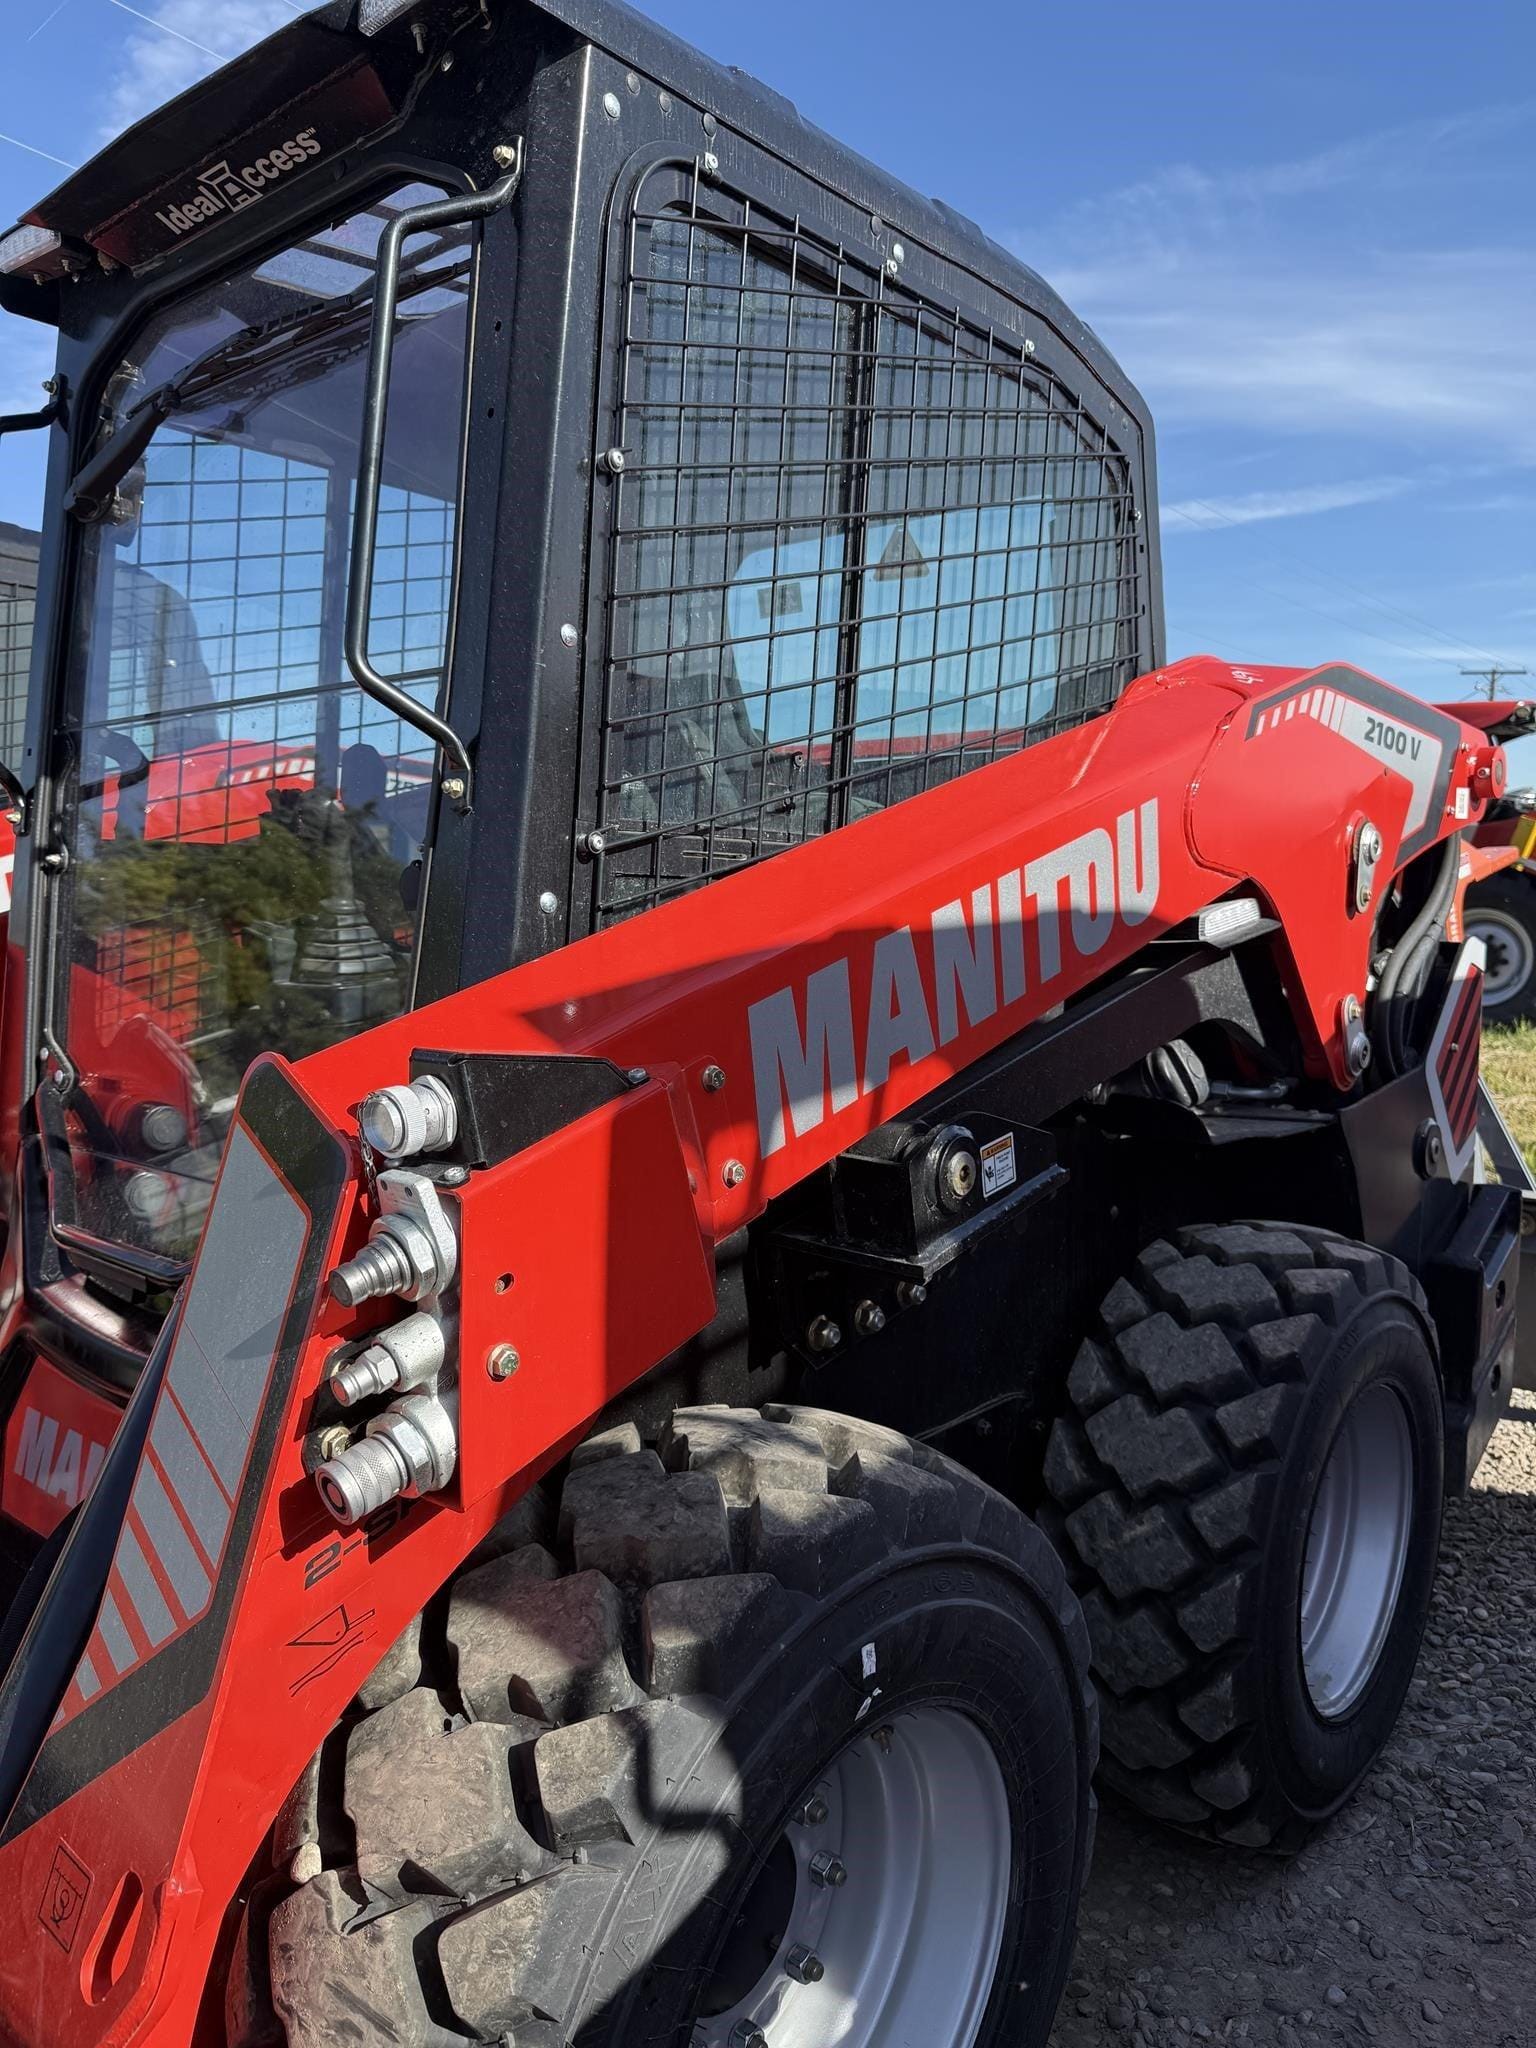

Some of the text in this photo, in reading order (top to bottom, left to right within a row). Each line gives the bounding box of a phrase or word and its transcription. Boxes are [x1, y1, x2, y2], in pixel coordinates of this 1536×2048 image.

[154, 185, 226, 236] Ideal
[1364, 716, 1422, 762] 2100 V
[747, 796, 1160, 1160] MANITOU
